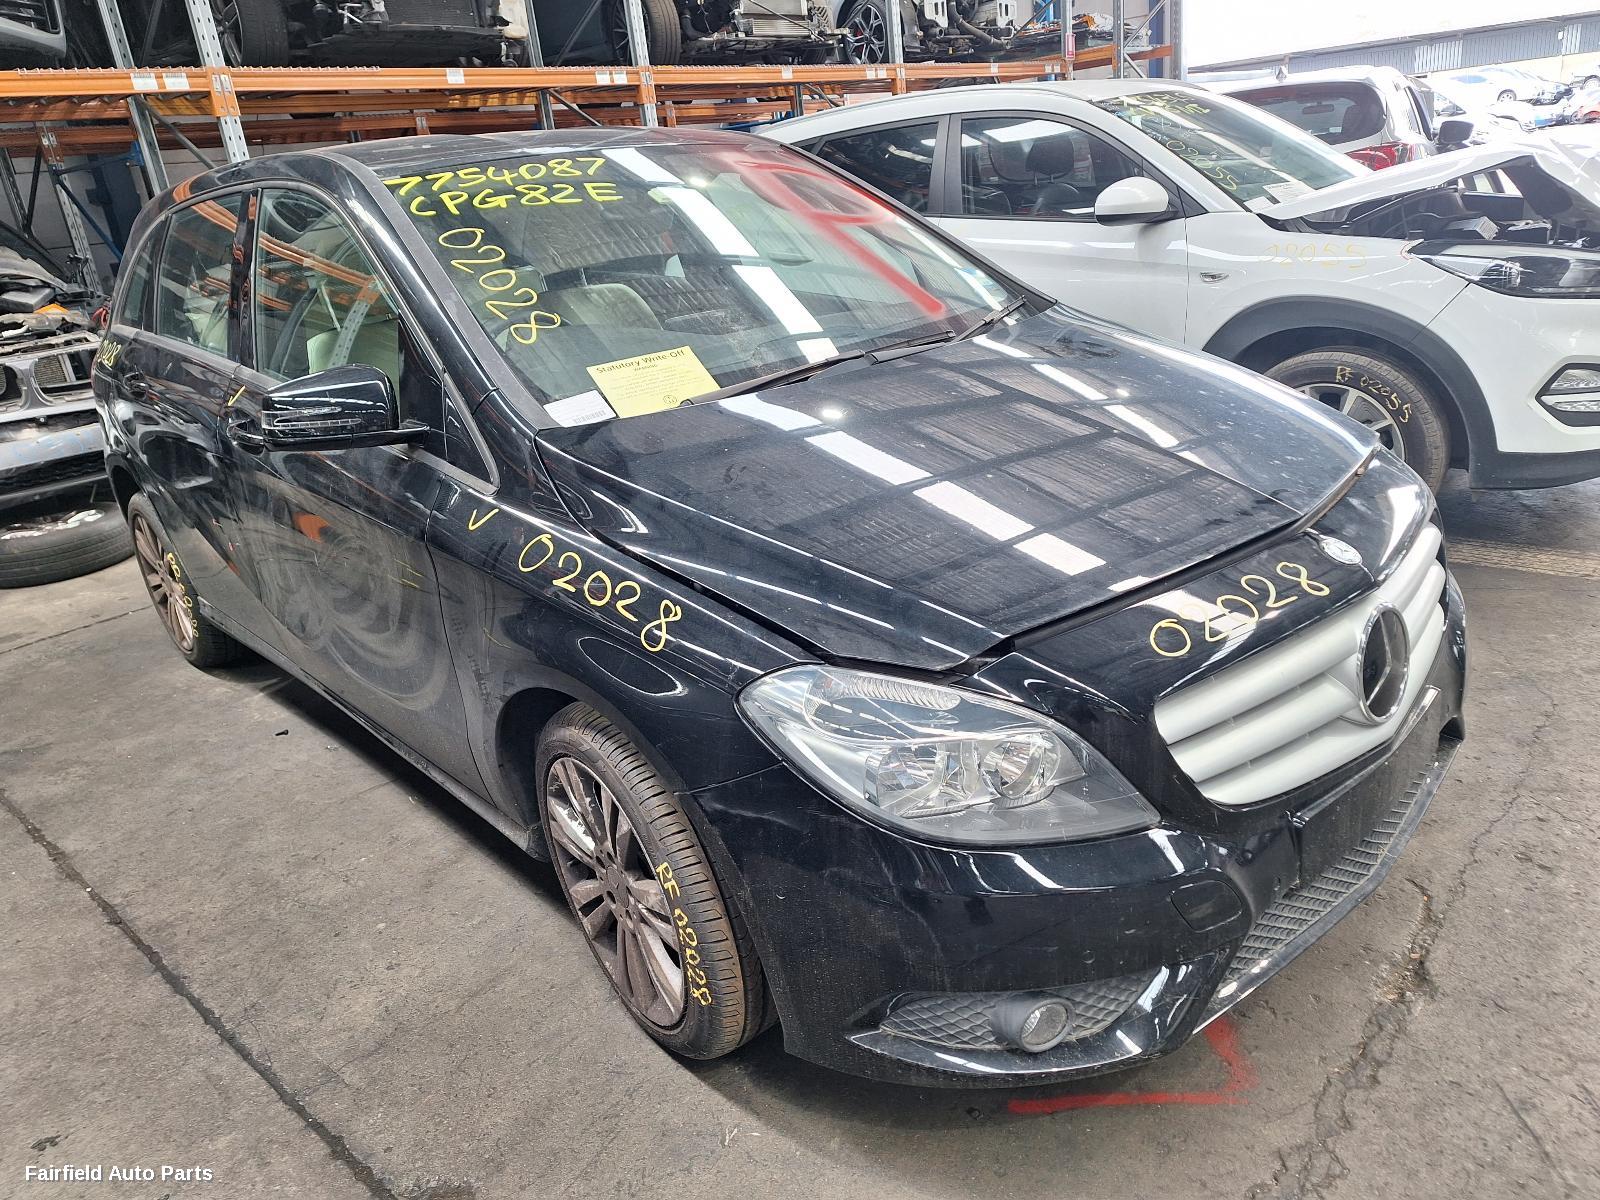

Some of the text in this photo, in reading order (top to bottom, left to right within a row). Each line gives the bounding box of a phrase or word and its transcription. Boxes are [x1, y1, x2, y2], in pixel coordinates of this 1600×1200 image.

[383, 156, 606, 197] 7754087
[409, 182, 624, 217] CPG82E
[438, 227, 562, 345] 02028
[596, 348, 686, 374] Statutory Write-Off
[1360, 375, 1413, 423] 02055
[518, 533, 682, 652] 02028
[1150, 561, 1331, 657] 02028
[656, 861, 713, 1006] RF 02028
